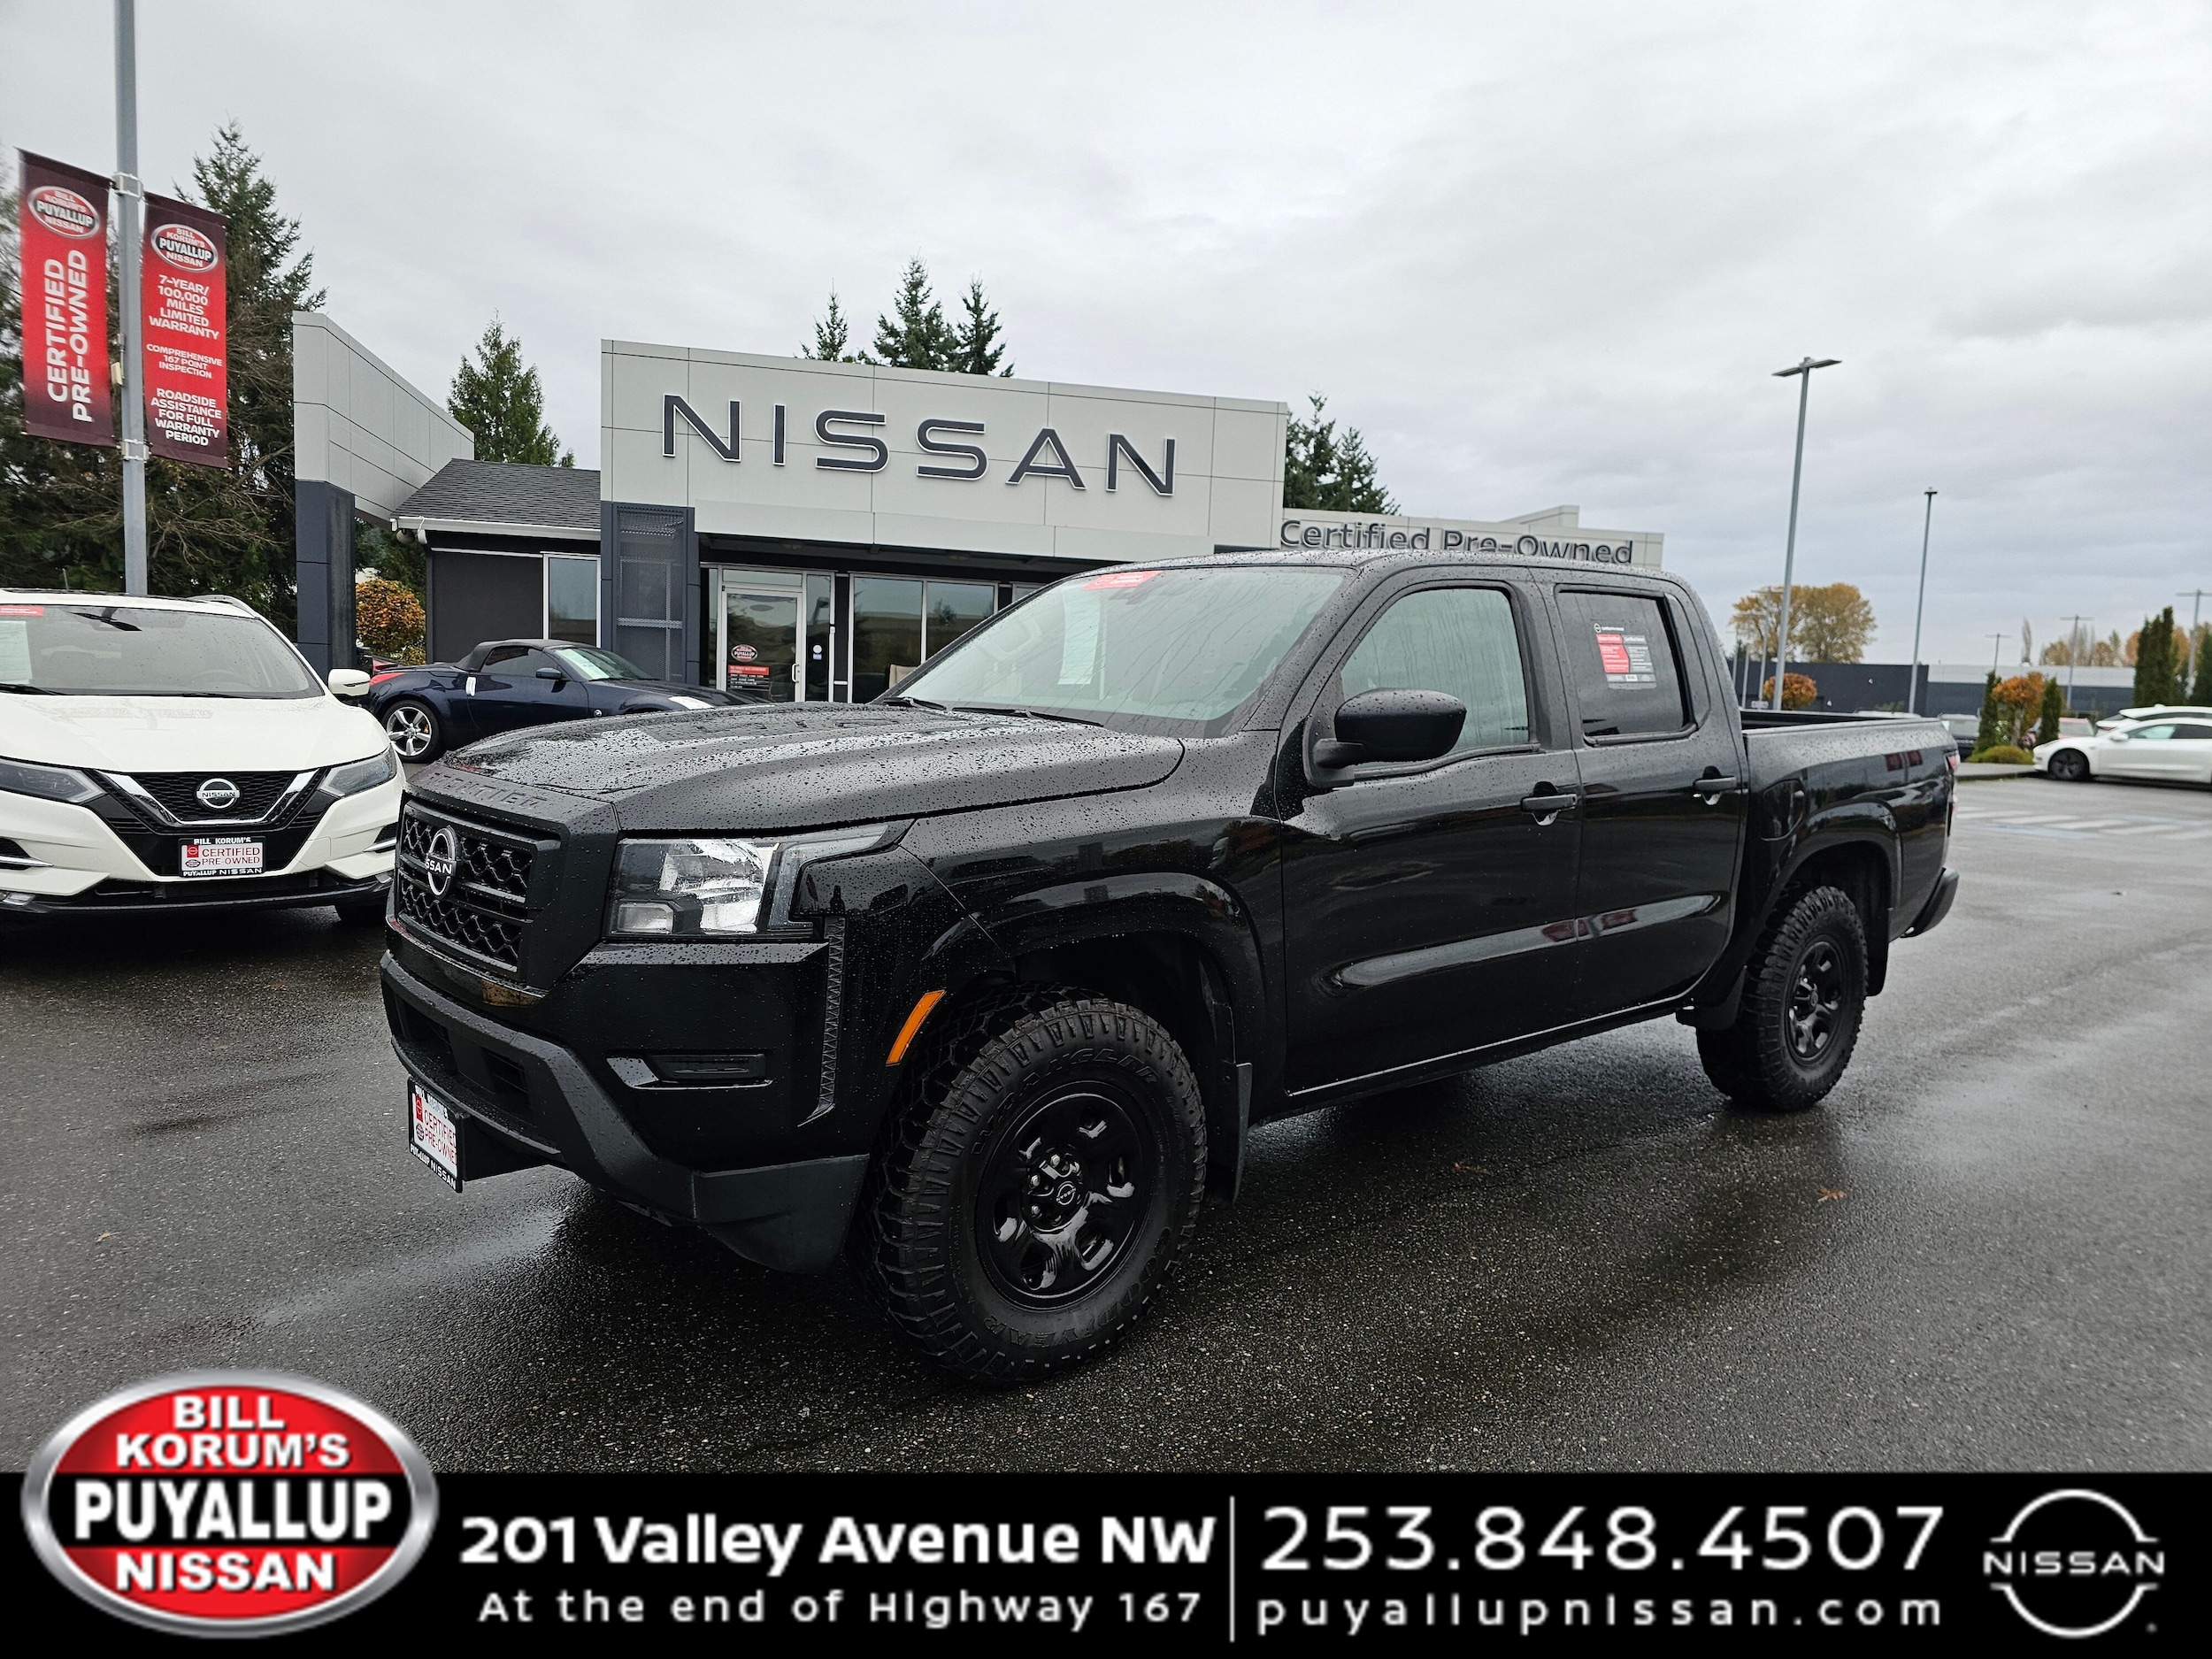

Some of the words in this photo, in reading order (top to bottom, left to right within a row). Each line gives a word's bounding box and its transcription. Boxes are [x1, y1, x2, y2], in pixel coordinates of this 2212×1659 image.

[54, 190, 76, 203] BILL
[36, 200, 93, 227] PUYALLUP
[44, 215, 84, 234] NISSAN
[176, 228, 195, 238] BILL
[158, 238, 212, 261] PUYALLUP
[165, 251, 204, 267] NISSAN
[157, 285, 209, 306] 100,000
[159, 274, 210, 296] 7-YEAR/
[159, 307, 209, 327] LIMITED
[166, 298, 204, 316] MILES
[44, 259, 68, 403] CERTIFIED
[68, 250, 92, 423] PRE-OWNED
[149, 315, 219, 340] WARRANTY
[146, 343, 223, 366] COMPREHENSIVE
[163, 354, 180, 363] 167
[180, 357, 208, 370] POINT
[158, 361, 212, 379] INSPECTION
[150, 397, 222, 419] ASSISTANCE
[156, 388, 217, 409] ROADSIDE
[154, 417, 220, 439] WARRANTY
[158, 408, 185, 422] FOR
[185, 413, 214, 427] FULL
[165, 429, 209, 446] PERIOD
[662, 394, 1177, 496] NISSAN
[1279, 519, 1432, 551] Certified
[1442, 529, 1633, 565] Pre-Owned
[215, 836, 251, 845] KORUM'S
[202, 847, 260, 857] CERTIFIED
[202, 856, 260, 865] PRE-OWNED
[430, 1160, 457, 1190] NISSAN
